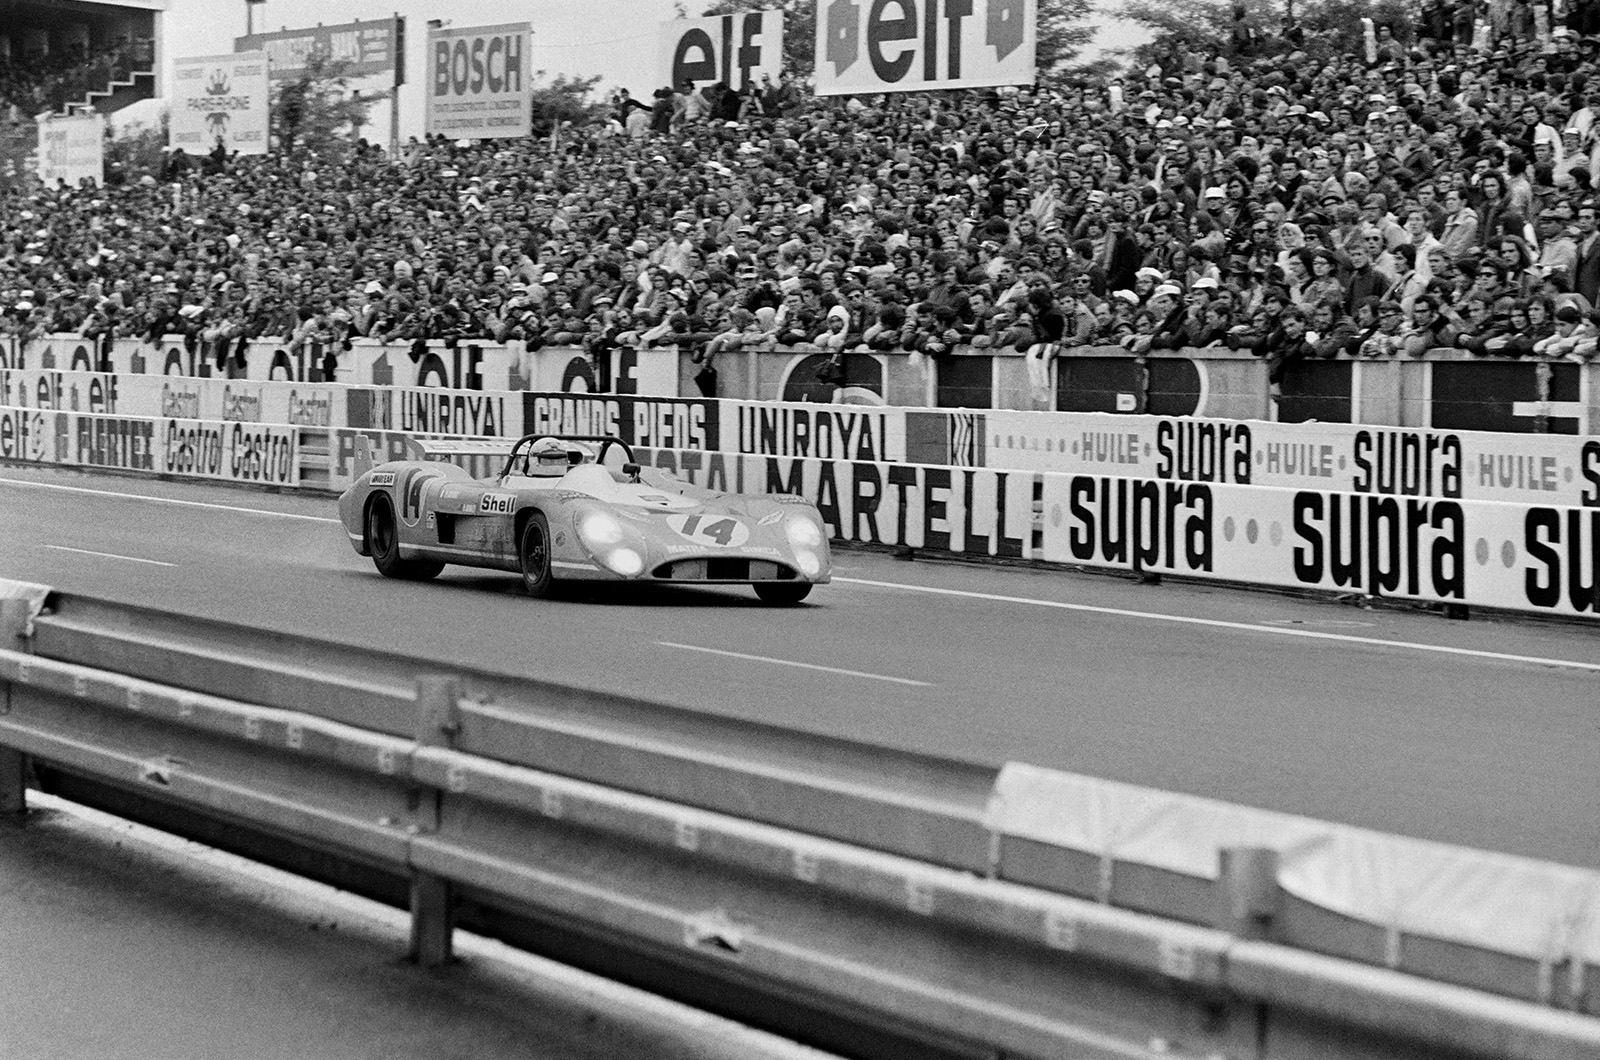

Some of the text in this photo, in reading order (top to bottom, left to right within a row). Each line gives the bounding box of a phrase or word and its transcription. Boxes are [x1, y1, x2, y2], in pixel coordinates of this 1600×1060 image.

[435, 35, 521, 96] BOSCH
[672, 12, 763, 92] elf
[89, 374, 118, 414] elf
[1, 411, 28, 459] elf
[165, 419, 224, 474] Castrol
[231, 423, 296, 484] Castrol
[534, 397, 706, 451] GRANDS PIEDS
[739, 405, 897, 463] UNIROYAL
[1082, 420, 1251, 484] HUILE supra
[1267, 430, 1462, 498] HUILE supra
[1479, 453, 1557, 491] HUILE
[403, 468, 438, 519] 14
[481, 494, 516, 513] Shell
[681, 515, 737, 545] 14
[1070, 476, 1213, 572] supra
[1293, 491, 1465, 599] supra
